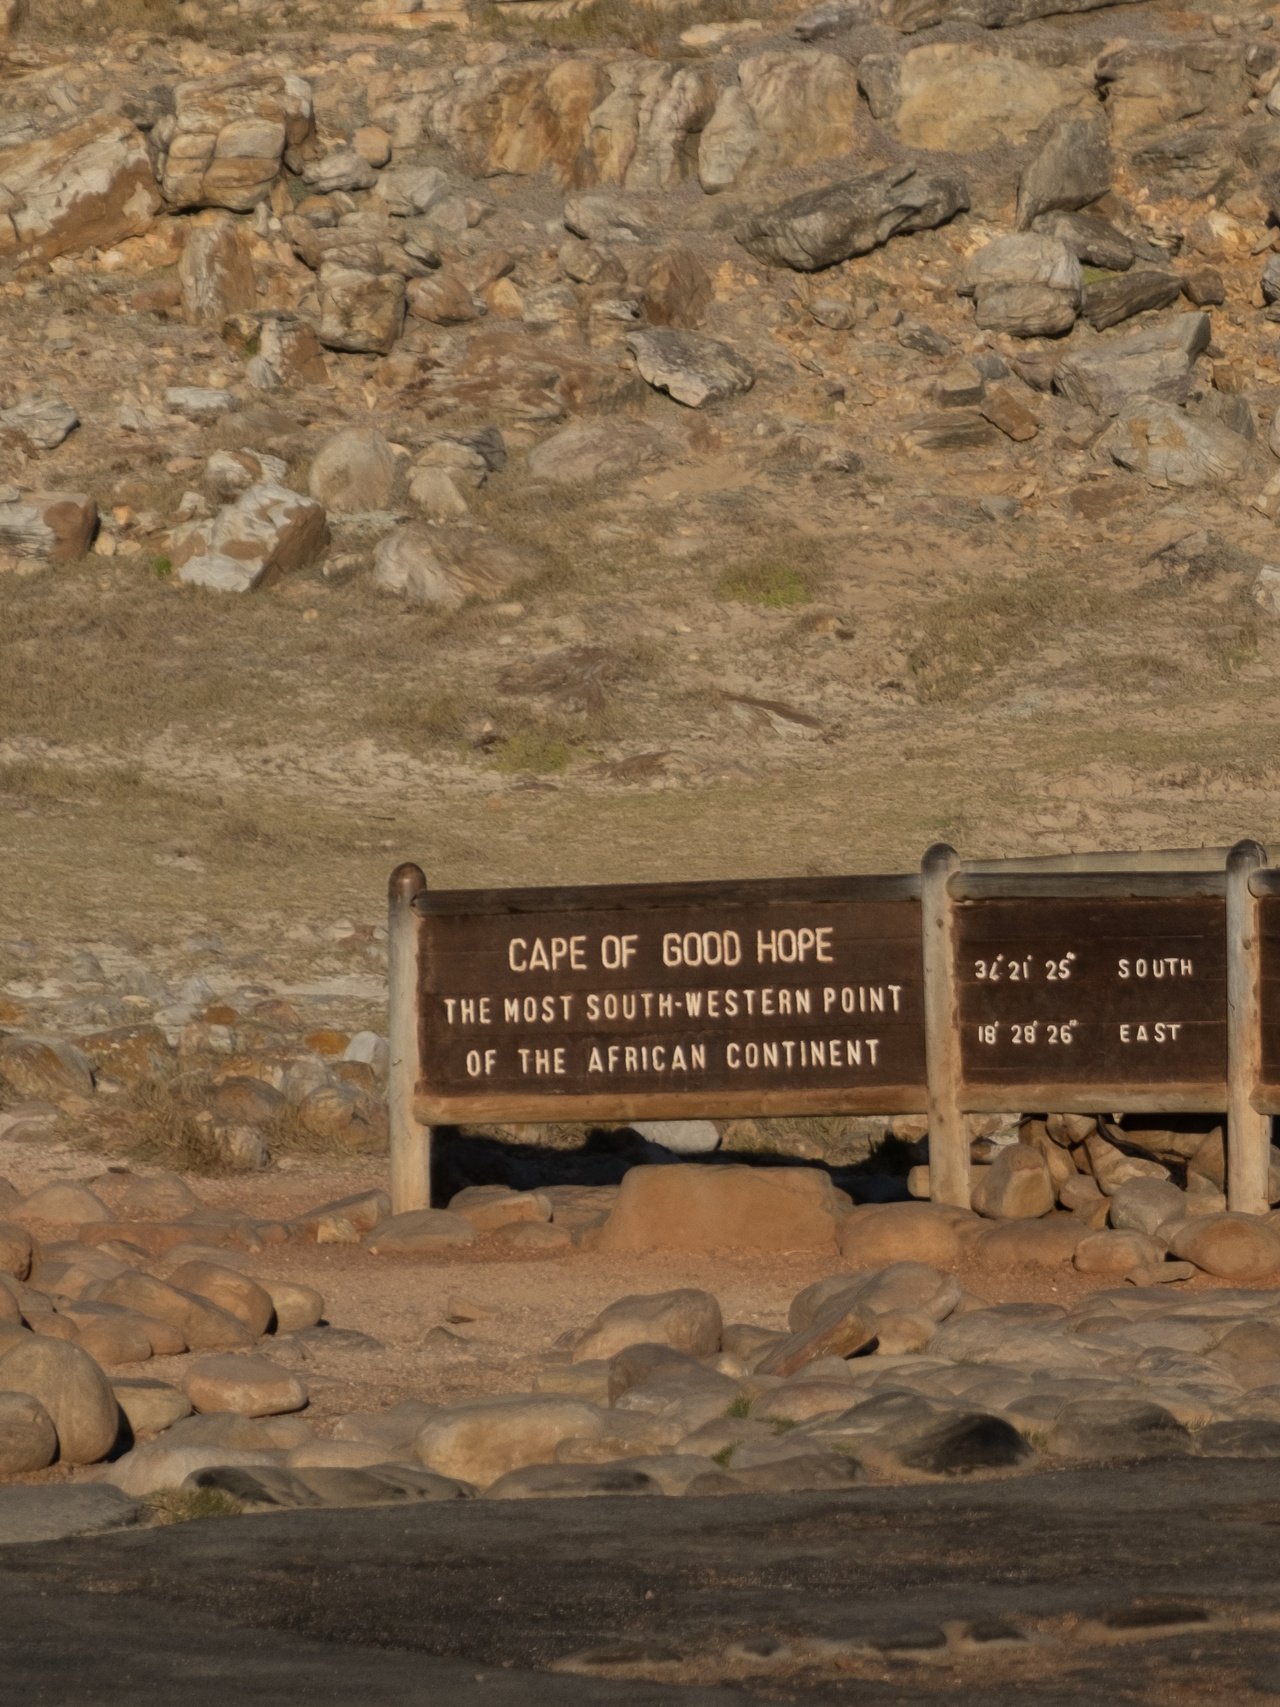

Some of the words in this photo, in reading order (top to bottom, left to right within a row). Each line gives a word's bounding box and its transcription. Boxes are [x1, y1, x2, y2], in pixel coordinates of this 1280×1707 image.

[508, 935, 588, 972] CAPE
[601, 934, 639, 970] OF
[662, 929, 742, 967] GOOD
[757, 927, 834, 964] HOPE
[1117, 957, 1193, 979] SOUTH
[443, 997, 492, 1025] THE
[504, 995, 573, 1024] MOST
[586, 988, 811, 1021] SOUTH-WESTERN
[823, 984, 902, 1013] POINT
[1119, 1022, 1182, 1043] EAST
[466, 1049, 497, 1077] OF
[517, 1047, 566, 1075] THE
[588, 1043, 706, 1073] AFRICAN
[726, 1038, 879, 1069] CONTINENT
